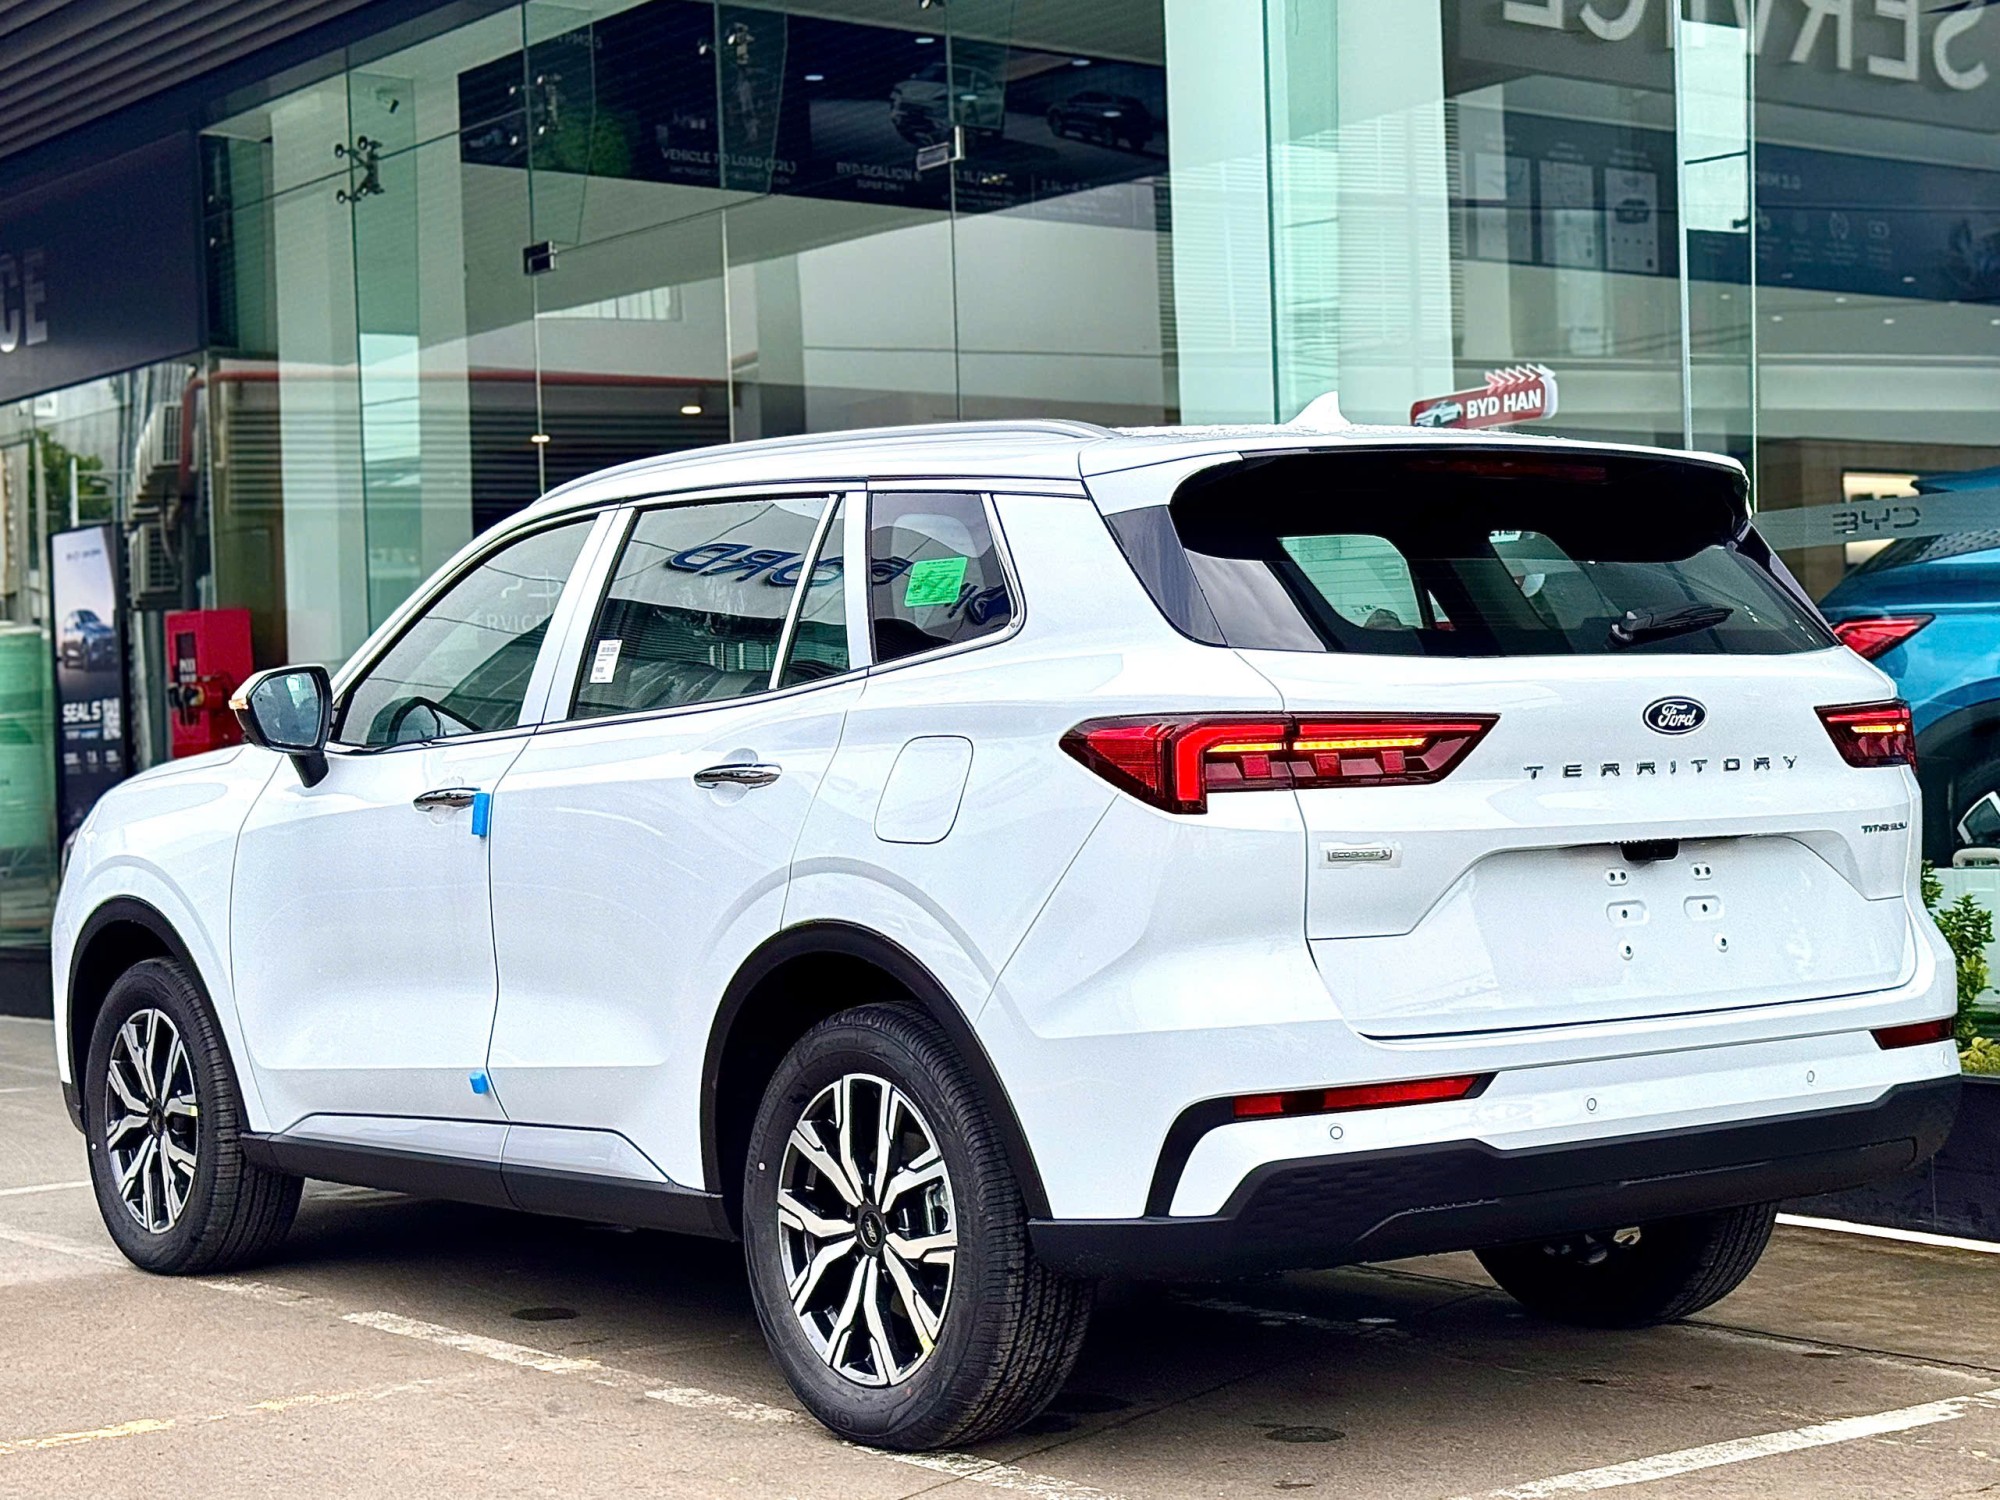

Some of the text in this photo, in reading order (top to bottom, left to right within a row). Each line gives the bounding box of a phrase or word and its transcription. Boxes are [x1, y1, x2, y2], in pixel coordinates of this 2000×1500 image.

[661, 147, 711, 164] VEHICLE
[731, 153, 763, 168] LOAD
[1465, 388, 1541, 419] BYD HAN
[1833, 506, 1921, 534] BYD
[63, 701, 91, 723] SEAL
[1655, 702, 1699, 729] Ford
[1523, 756, 1798, 779] TERRITORY
